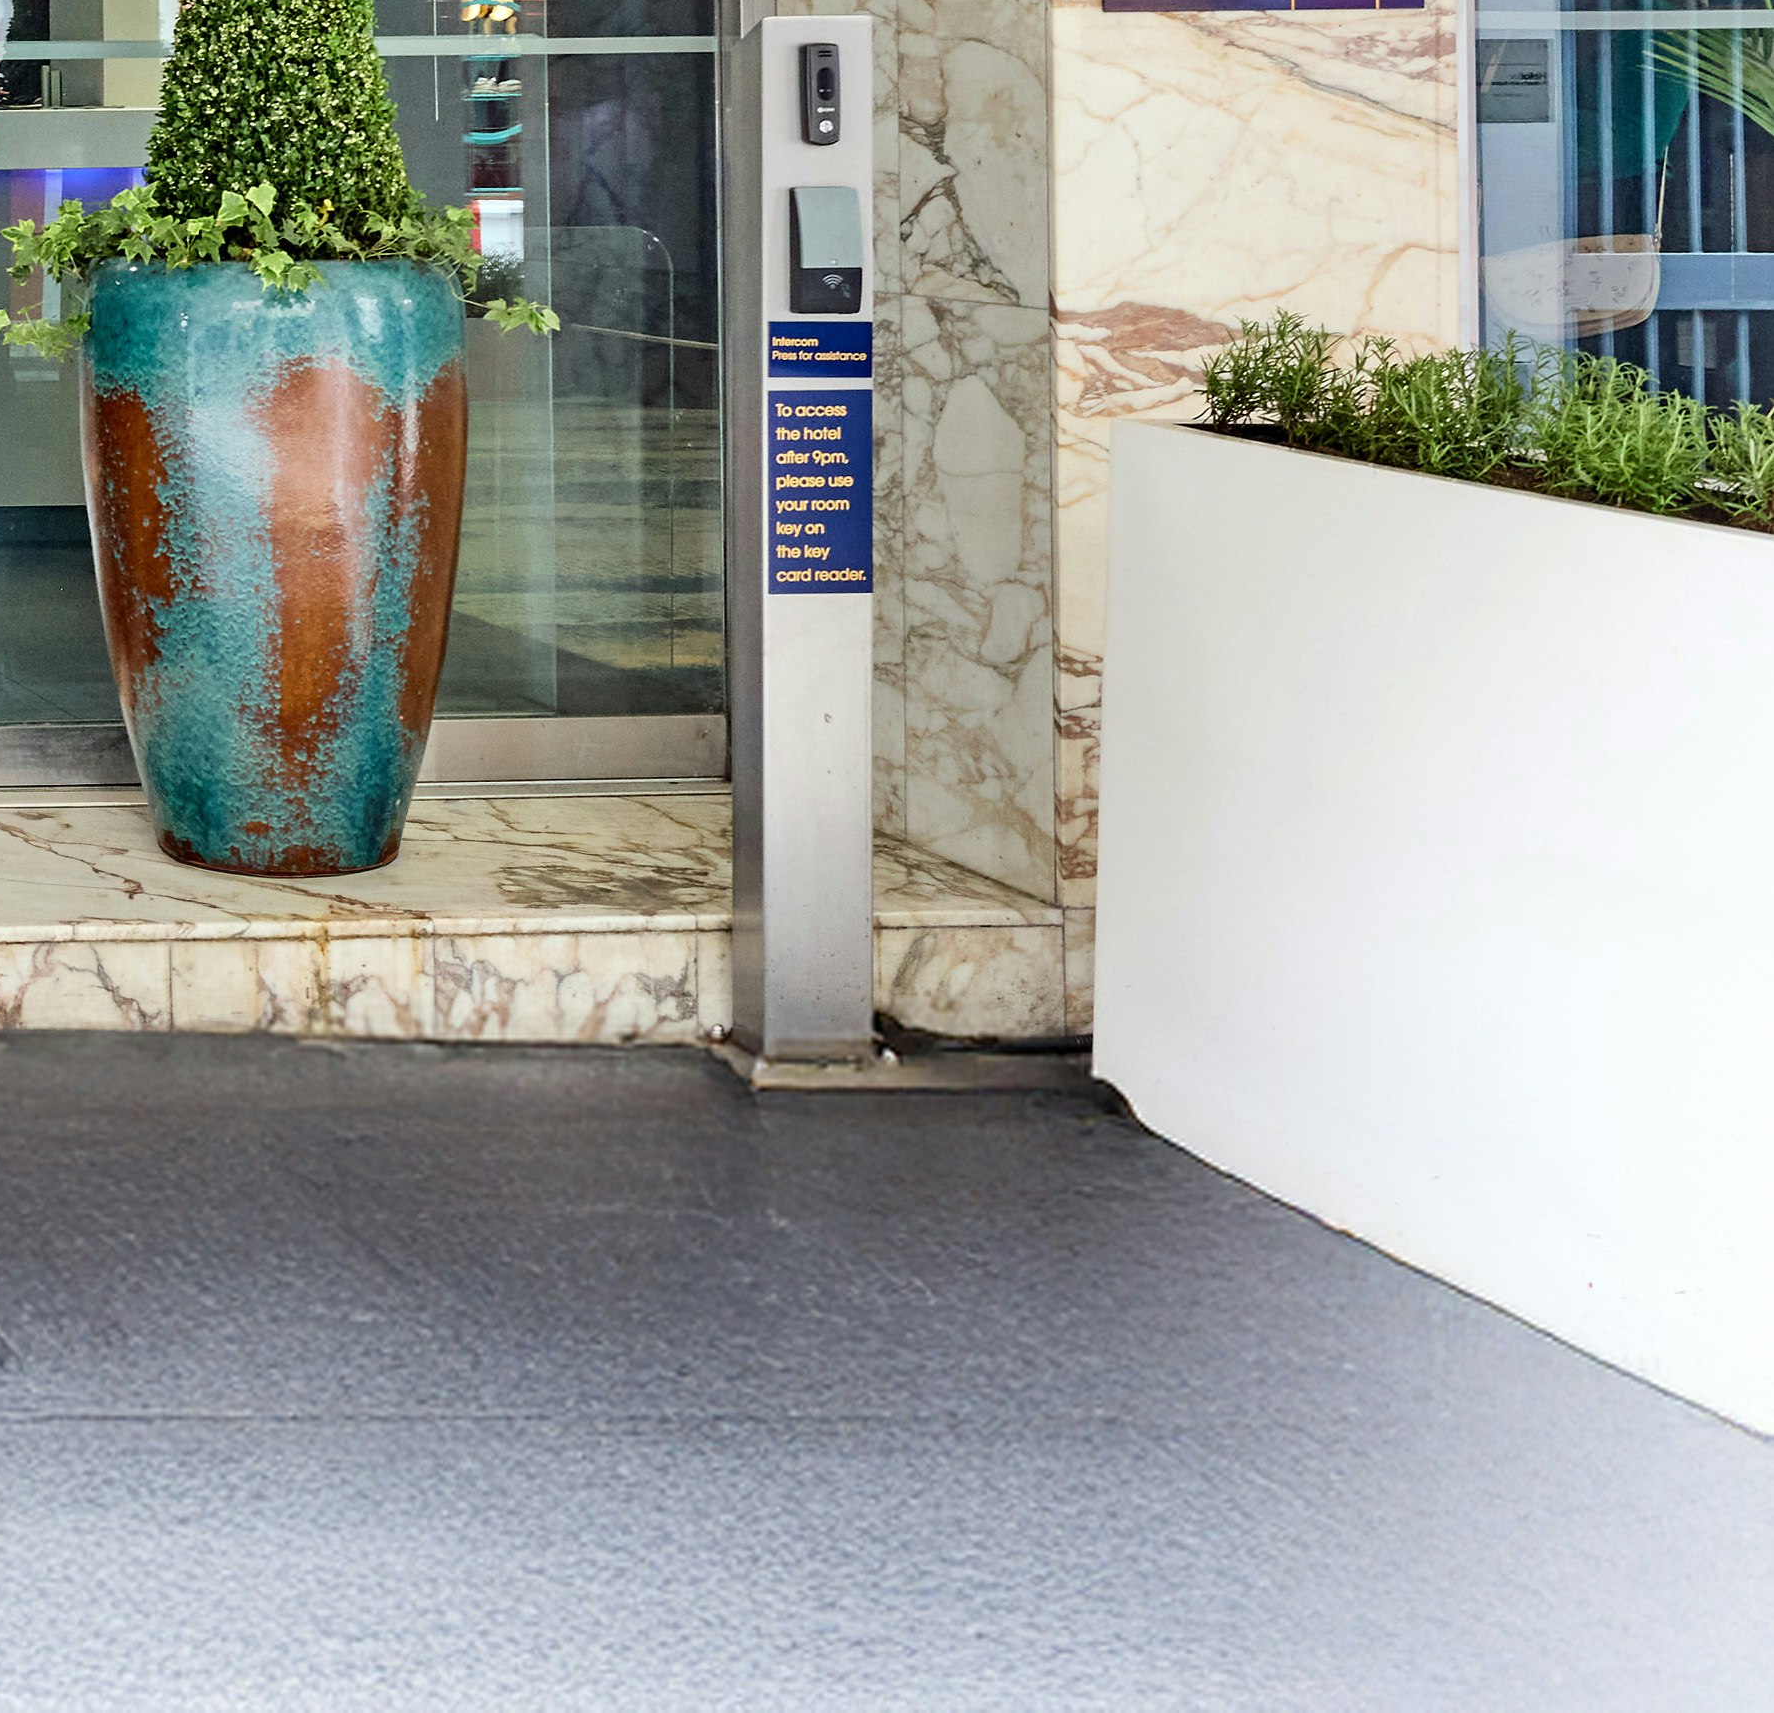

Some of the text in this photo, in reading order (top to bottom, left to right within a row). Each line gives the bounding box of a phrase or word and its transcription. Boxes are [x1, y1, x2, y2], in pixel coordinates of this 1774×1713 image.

[772, 337, 819, 347] Intercom
[772, 350, 868, 361] Press for assistance
[775, 403, 848, 417] To access
[775, 427, 841, 441] the hotel
[776, 450, 849, 466] after 9pm,
[776, 474, 854, 490] please use
[776, 499, 850, 514] your room
[776, 522, 825, 537] key on
[776, 545, 830, 560] the key
[776, 568, 867, 582] card reader.
